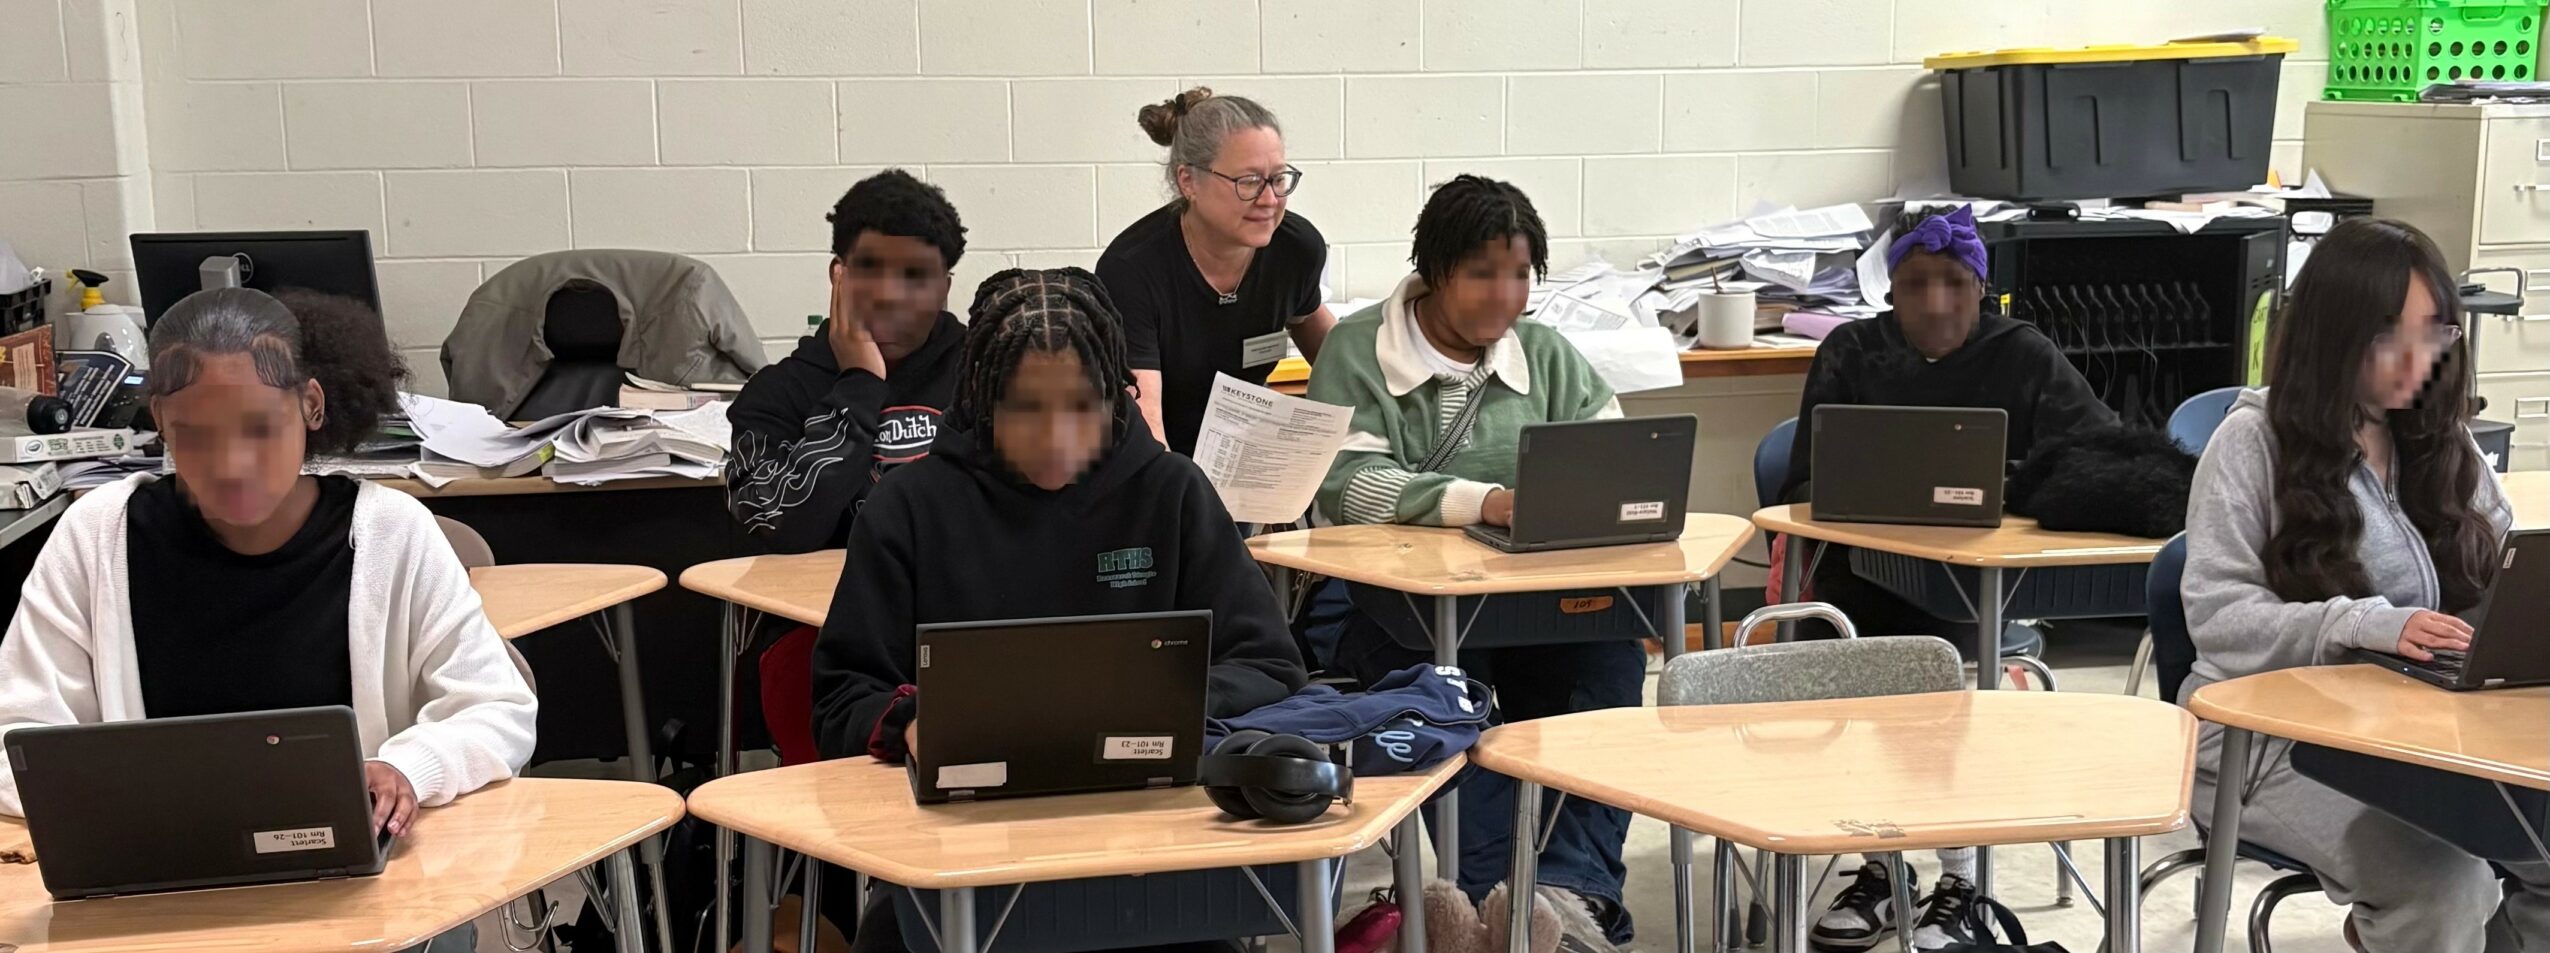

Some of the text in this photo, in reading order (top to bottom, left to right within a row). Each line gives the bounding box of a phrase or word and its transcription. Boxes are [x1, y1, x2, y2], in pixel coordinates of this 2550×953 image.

[1231, 388, 1274, 407] KEYSTONE
[892, 414, 938, 441] Dutch
[1097, 547, 1153, 572] RTHS
[1152, 740, 1165, 748] Rm
[1133, 748, 1164, 756] Scarlett
[310, 830, 326, 838] Rm
[290, 838, 327, 847] Scarlett
